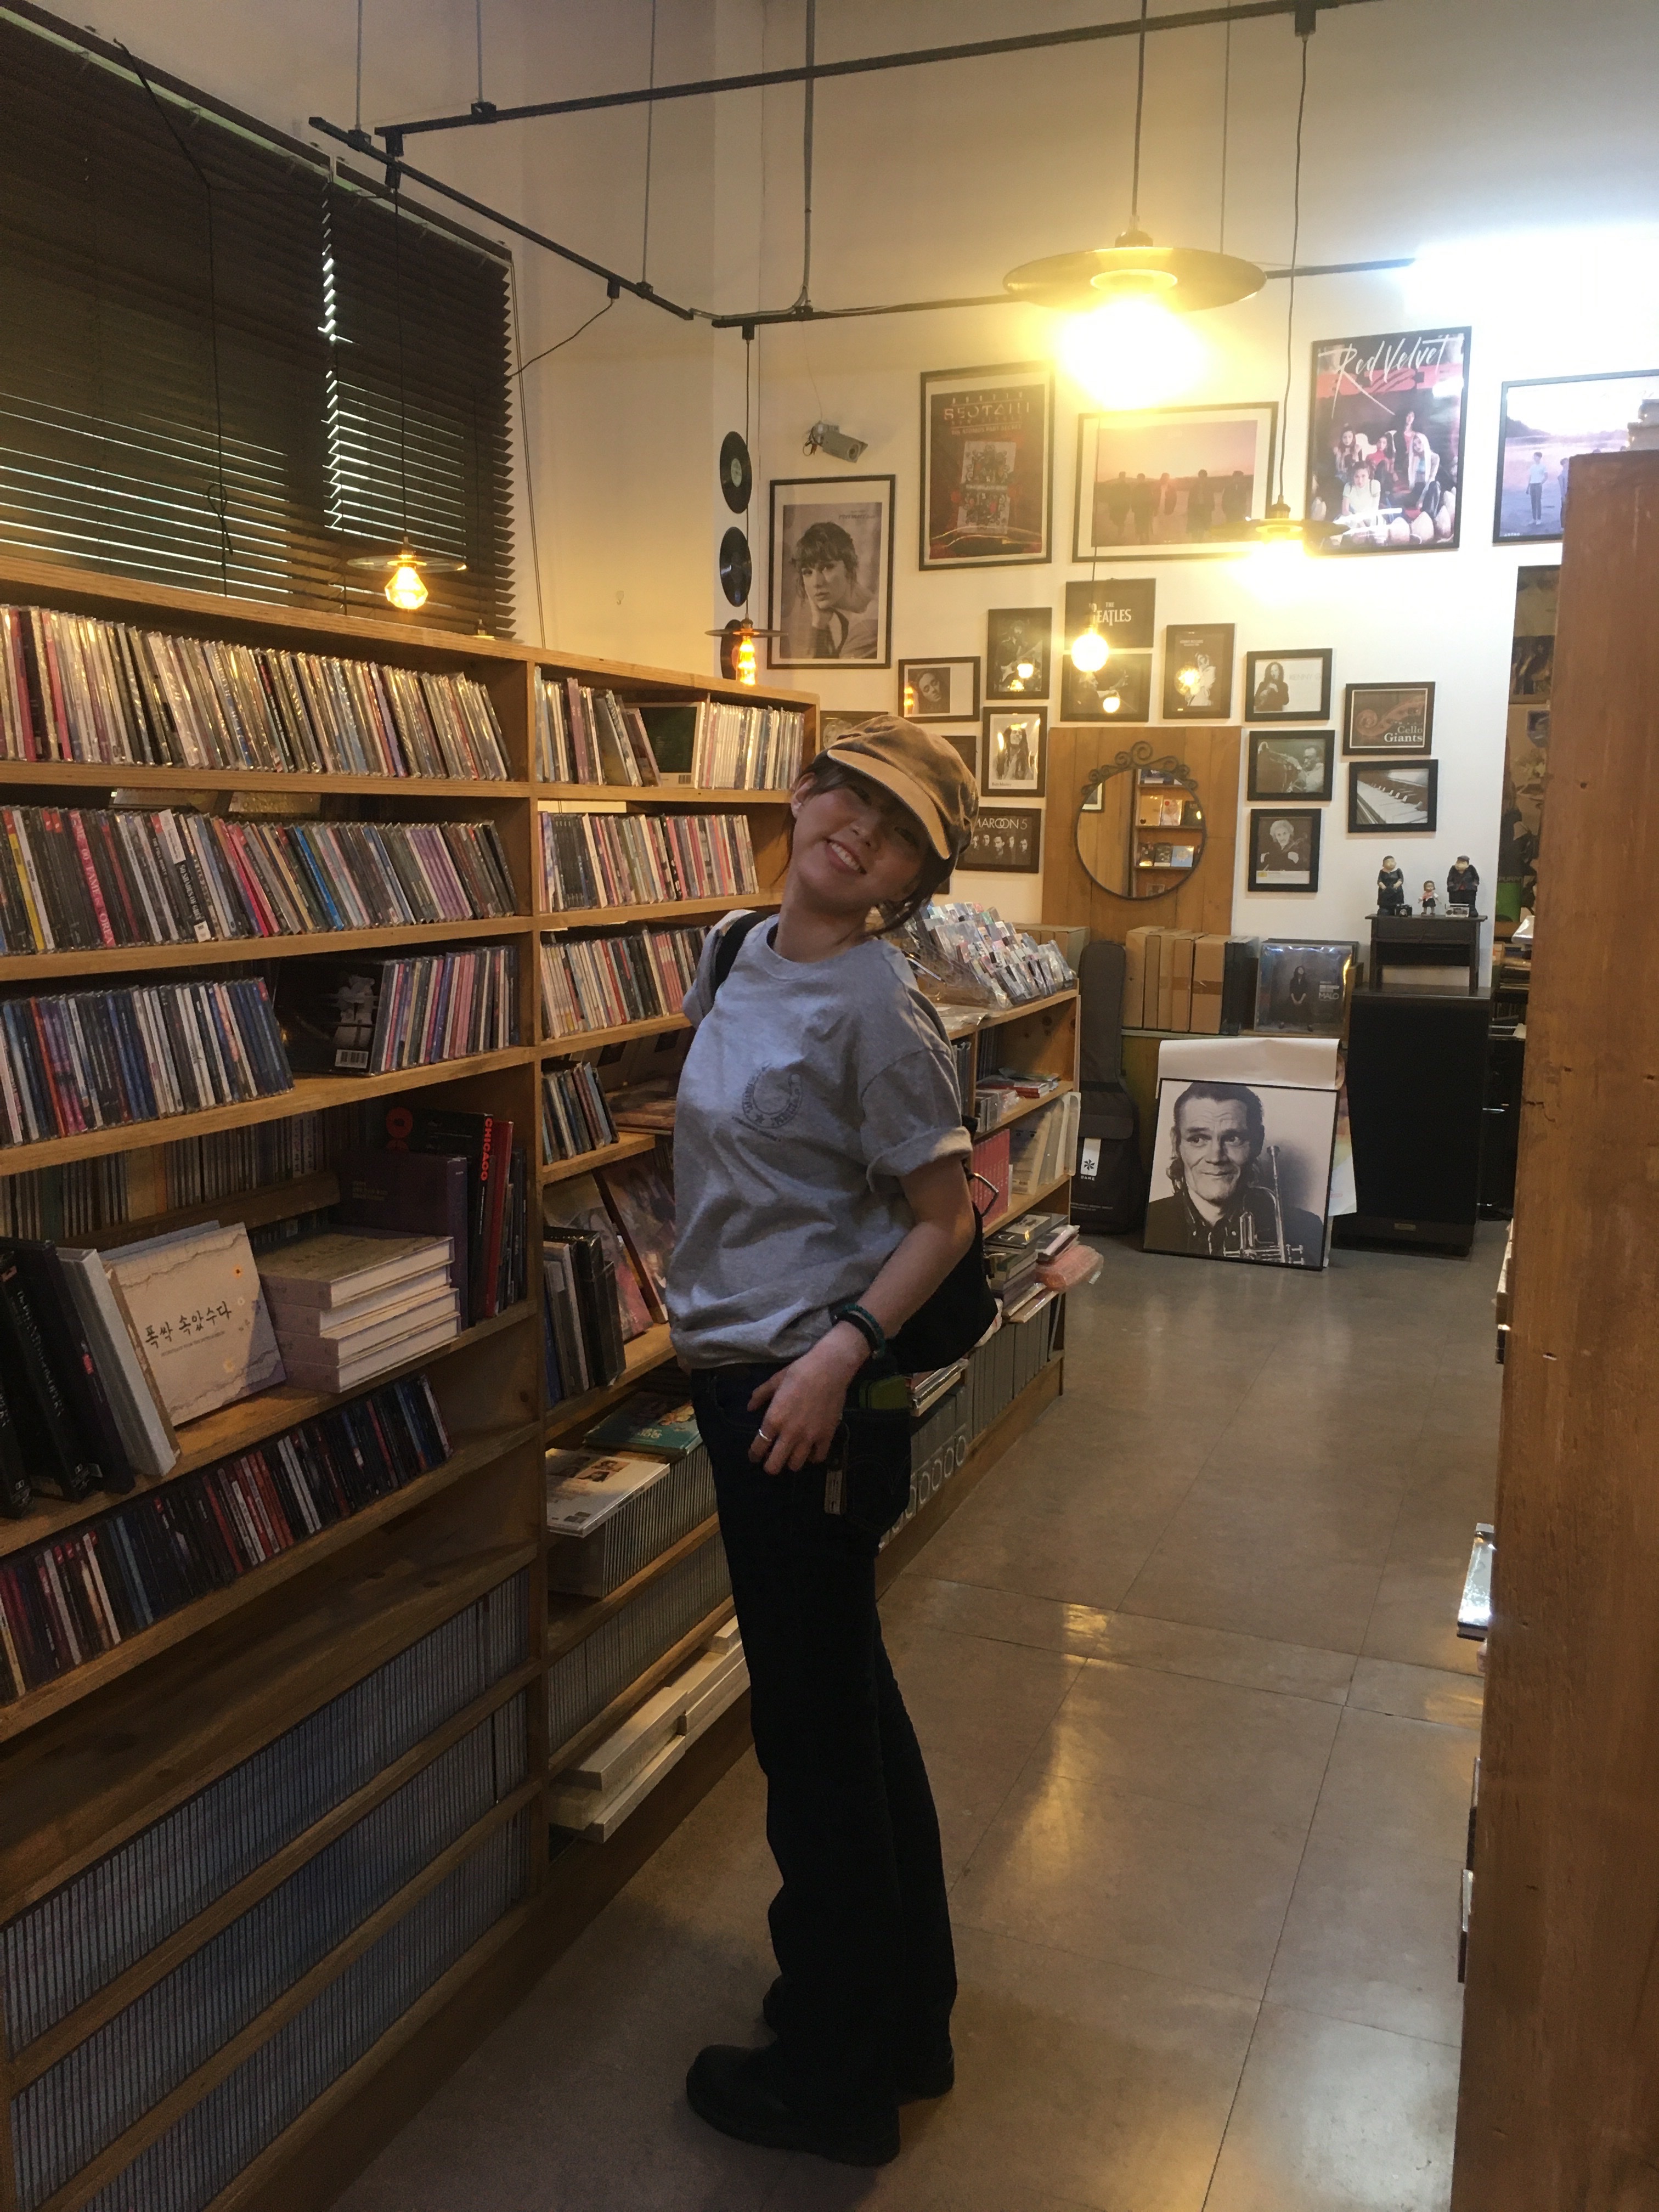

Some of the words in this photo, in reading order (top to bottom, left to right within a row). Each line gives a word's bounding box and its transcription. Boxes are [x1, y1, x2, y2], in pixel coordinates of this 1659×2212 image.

[1318, 342, 1396, 419] Red
[1383, 334, 1464, 383] Velvet
[1397, 725, 1423, 734] Cello
[1384, 732, 1423, 742] Giants
[1020, 819, 1028, 830] 5
[145, 1322, 173, 1348] 폭싹
[178, 1301, 233, 1337] 속았수다
